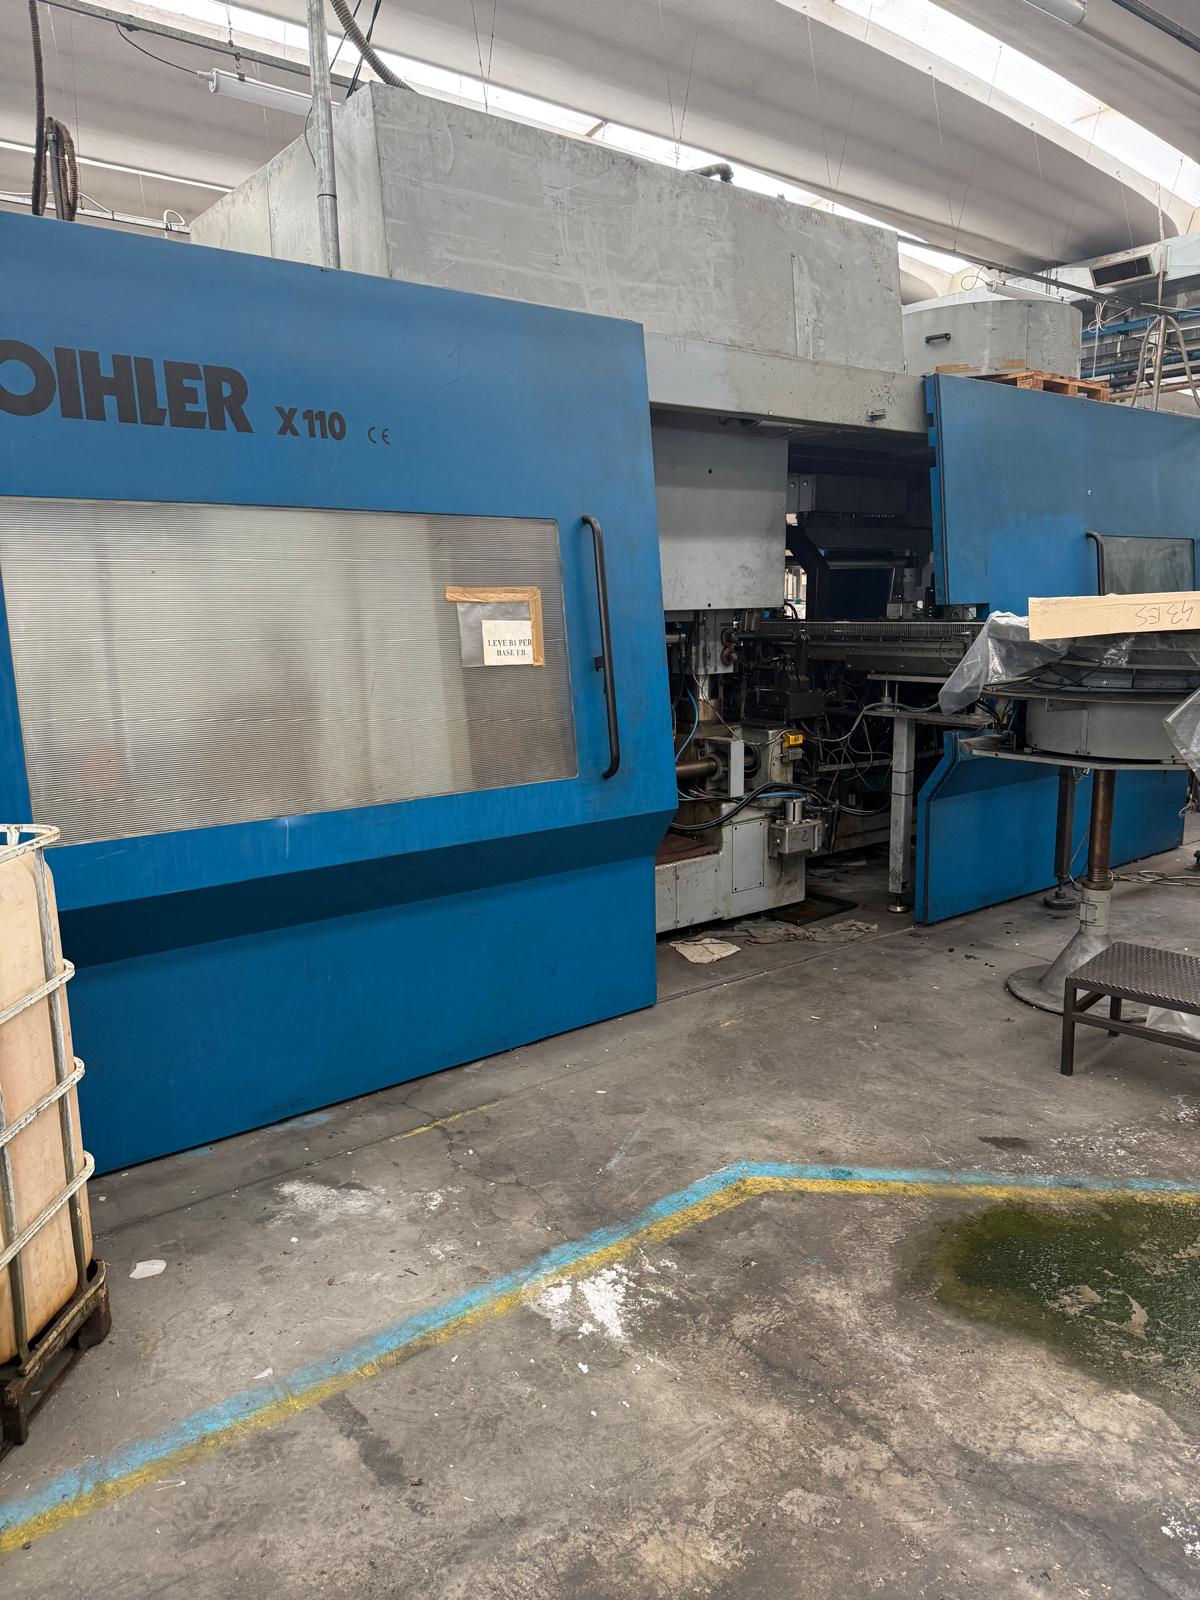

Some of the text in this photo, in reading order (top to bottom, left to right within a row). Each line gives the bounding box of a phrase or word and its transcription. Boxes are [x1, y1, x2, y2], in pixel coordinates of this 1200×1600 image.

[487, 639, 508, 647] LEVE
[518, 638, 533, 647] PER
[496, 649, 515, 657] BASE
